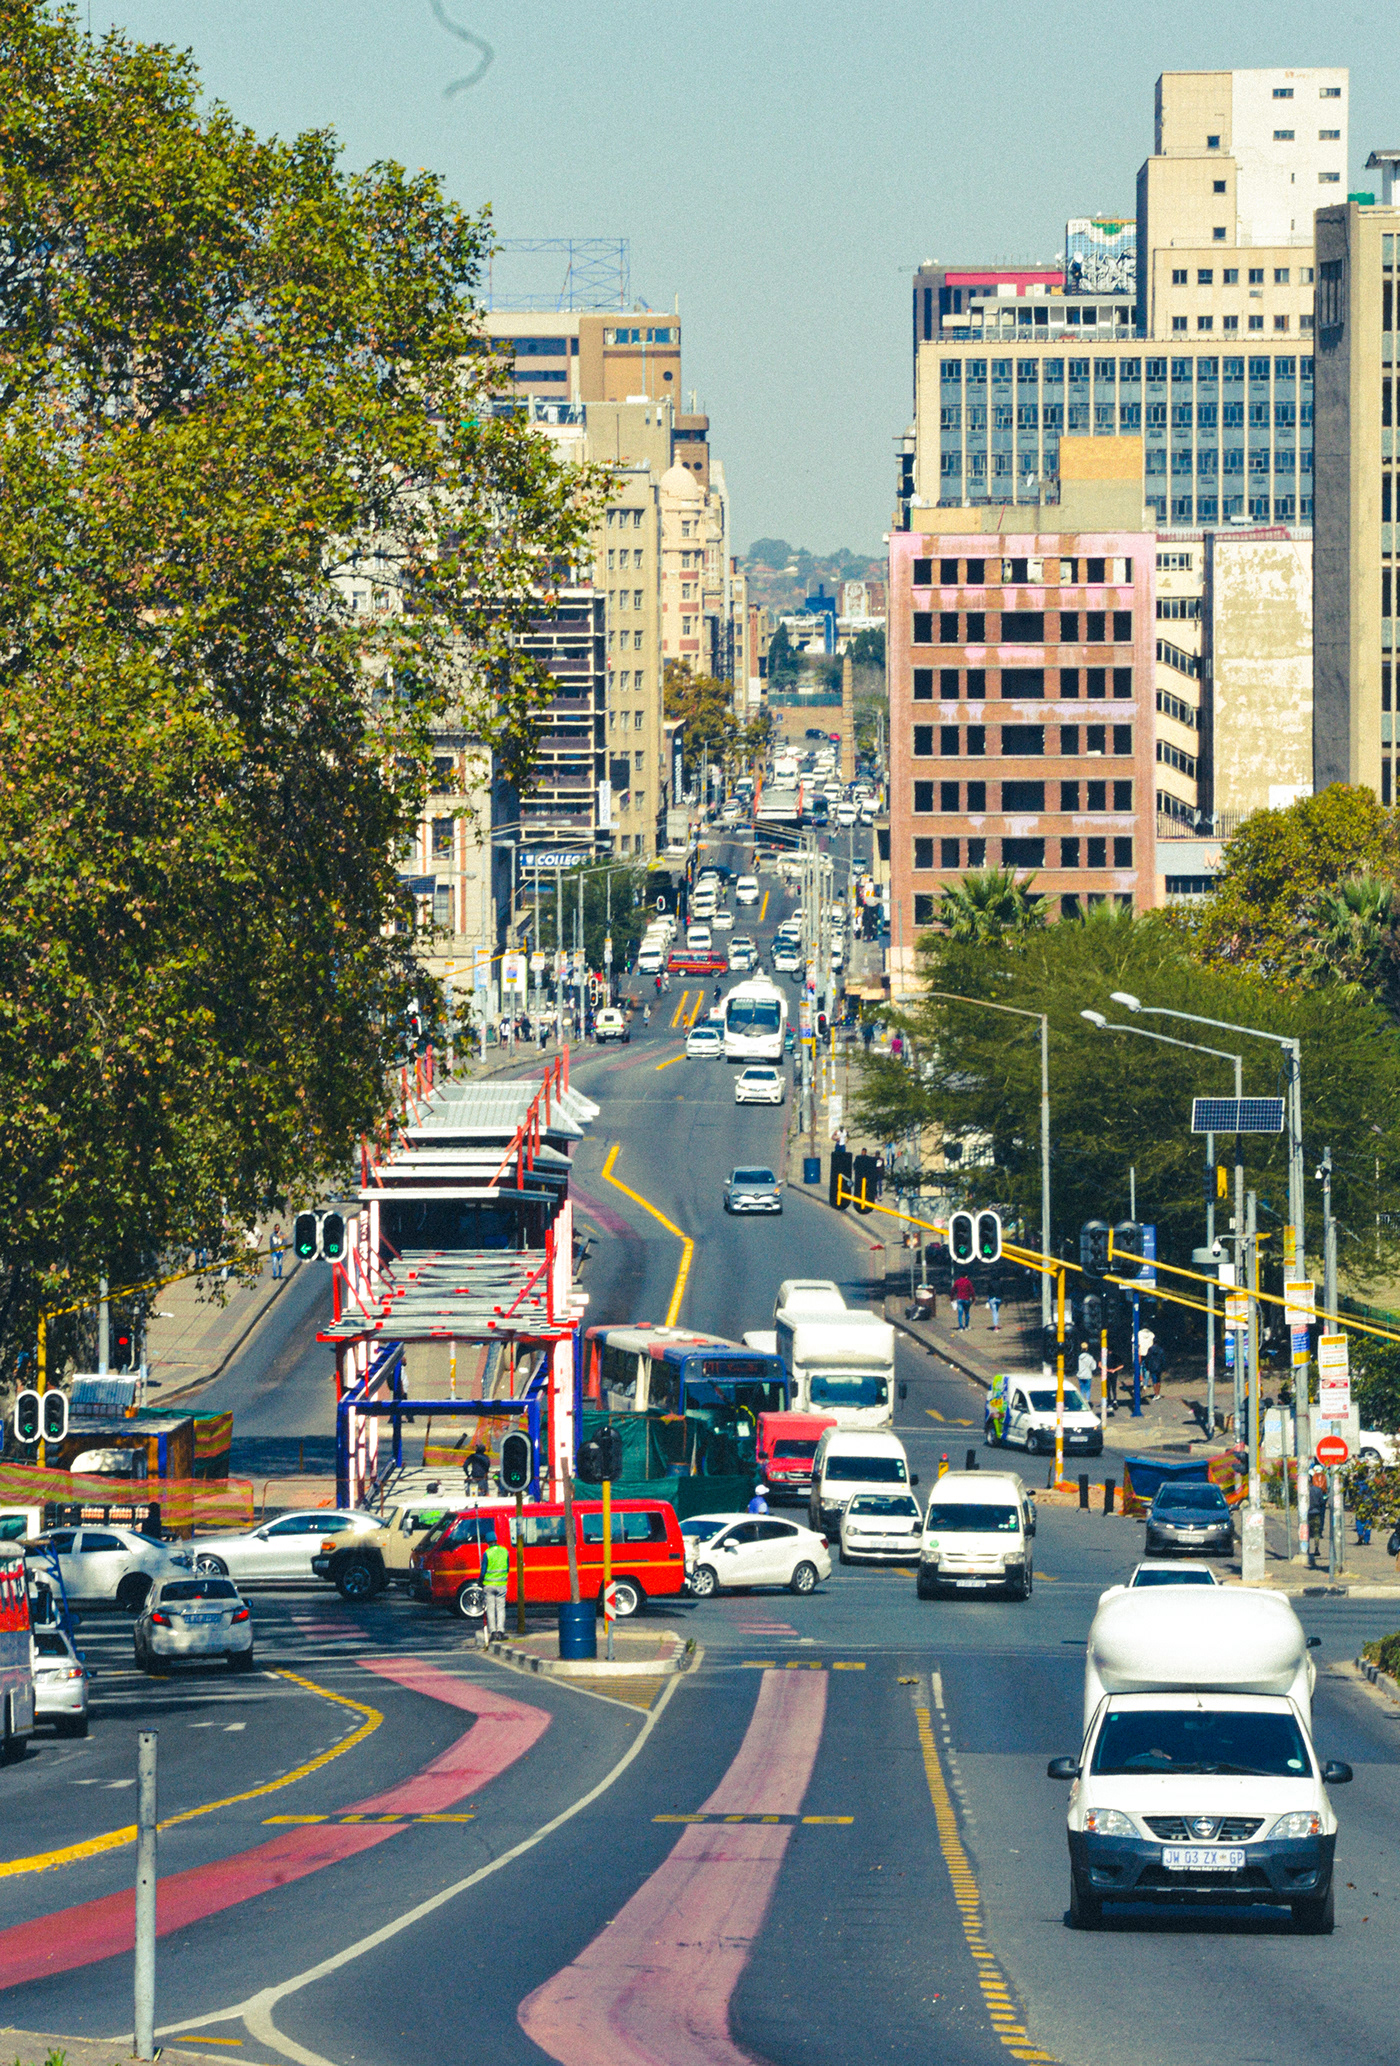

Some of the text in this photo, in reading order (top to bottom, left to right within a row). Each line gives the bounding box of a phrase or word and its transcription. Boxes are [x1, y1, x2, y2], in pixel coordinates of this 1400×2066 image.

[1166, 1850, 1243, 1865] JW 03 ZX GP
